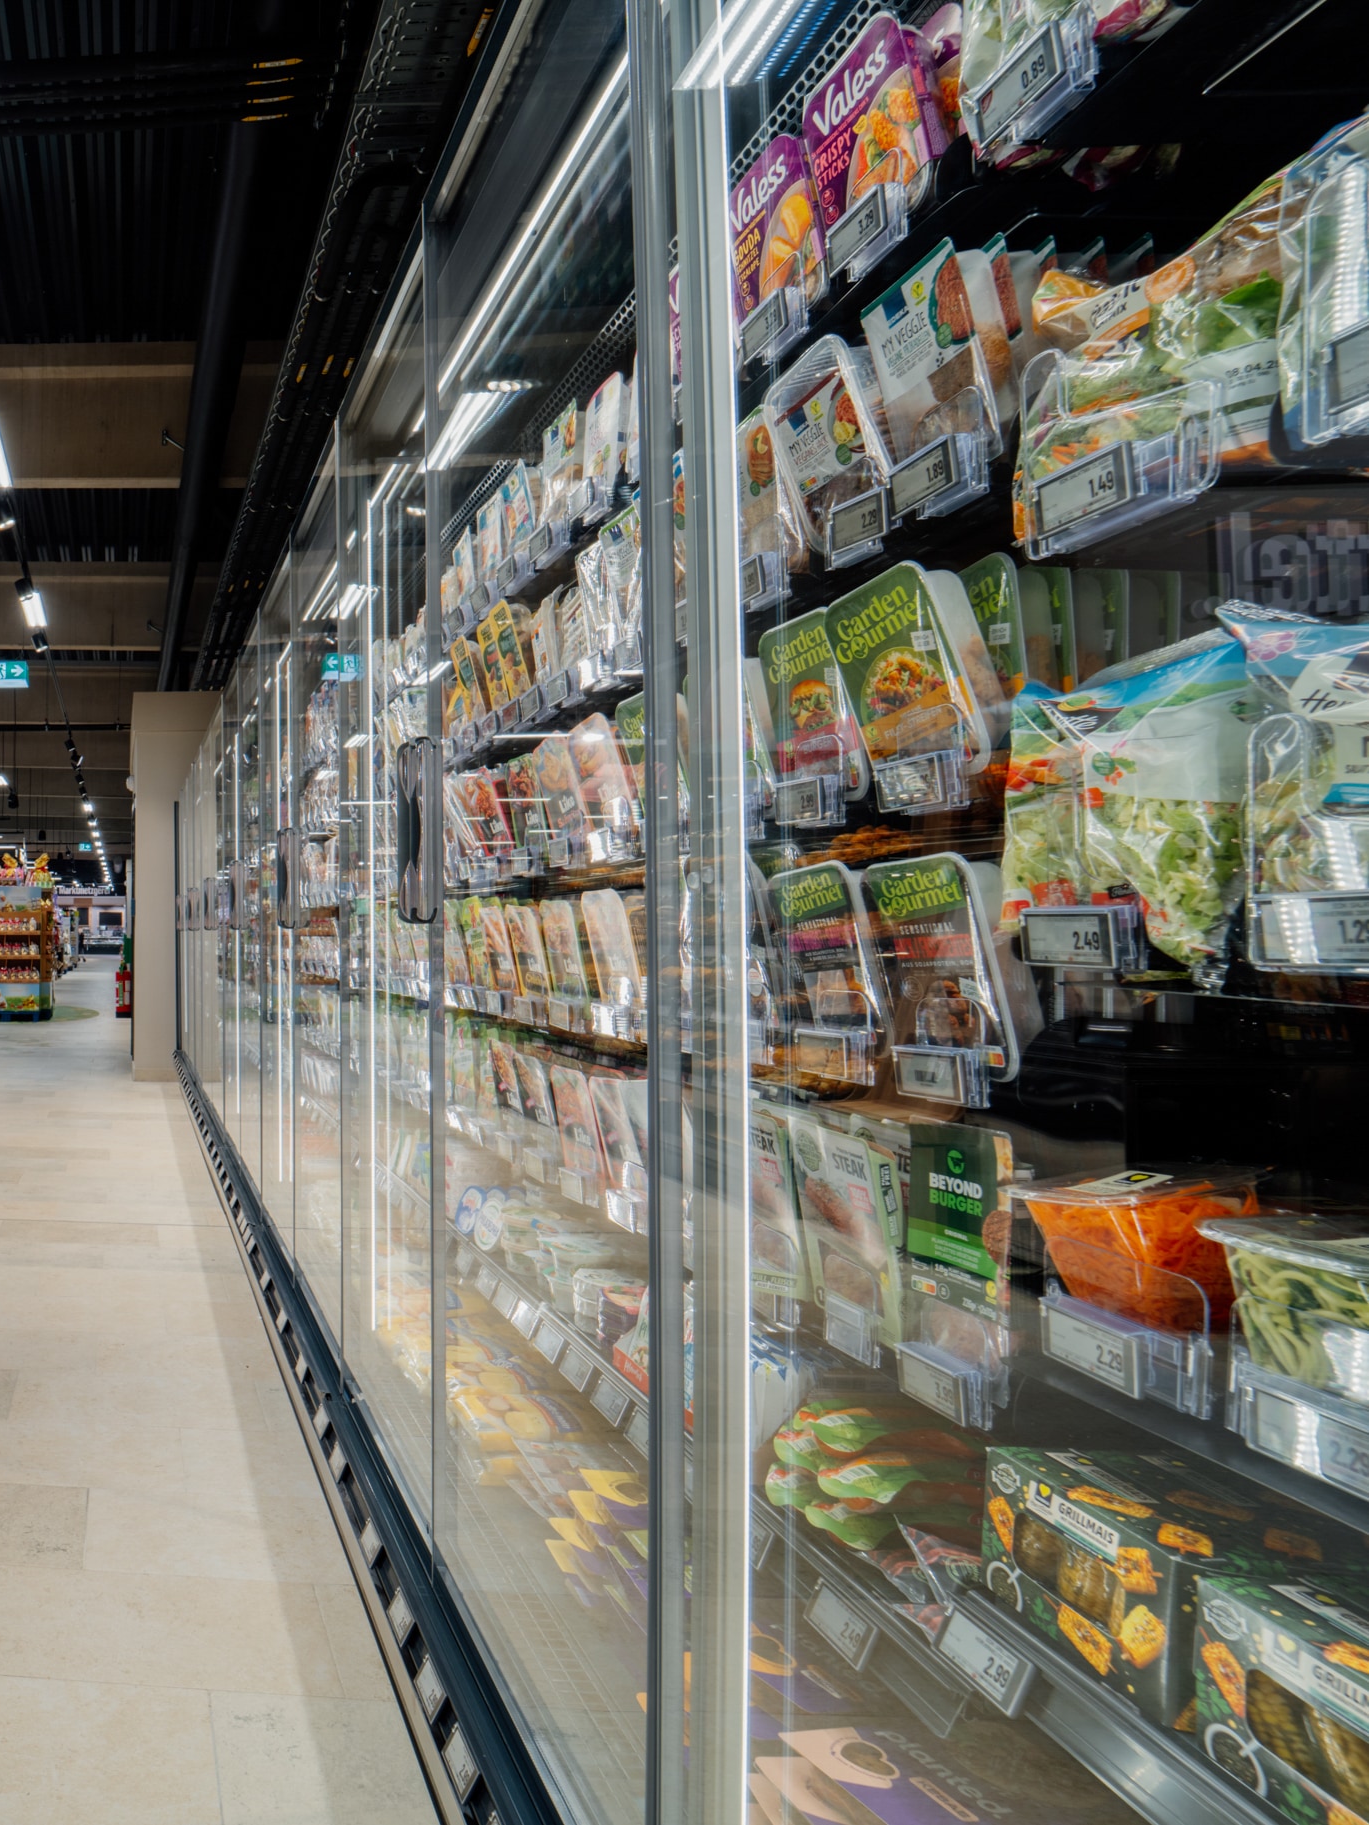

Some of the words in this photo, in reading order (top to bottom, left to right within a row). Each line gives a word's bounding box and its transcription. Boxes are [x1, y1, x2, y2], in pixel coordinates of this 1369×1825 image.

[1021, 54, 1046, 89] 0.89
[812, 40, 887, 137] Valess
[814, 127, 852, 176] CRISPY
[817, 150, 850, 191] STICKS
[730, 154, 786, 232] Valess
[857, 209, 874, 236] 3.29
[733, 227, 761, 267] GOUDA
[881, 336, 895, 359] MY
[894, 311, 928, 348] VEGGIE
[789, 438, 802, 458] MY
[801, 422, 825, 449] VEGGIE
[926, 459, 944, 484] 1.89
[1088, 470, 1115, 499] 1.49
[861, 508, 877, 529] 2.29
[835, 595, 924, 664] Gourmet
[836, 585, 909, 642] Garden
[771, 624, 827, 665] Garden
[768, 641, 832, 685] Gourme
[558, 793, 576, 814] Like
[490, 819, 504, 834] Like
[780, 882, 845, 917] Gourmet
[782, 872, 832, 902] Garden
[879, 880, 962, 917] Gourmet
[881, 868, 947, 898] Garden
[899, 921, 955, 935] SENSATIONAL
[1072, 930, 1100, 951] 2.49
[749, 1132, 777, 1156] TEAK
[833, 1153, 868, 1183] STEAK
[928, 1172, 983, 1200] BEYOND
[928, 1189, 983, 1218] BURGER
[1096, 1343, 1123, 1373] 2.29
[1058, 1502, 1115, 1546] GRILLMAIS
[839, 1622, 861, 1648] 2.49
[983, 1656, 1011, 1689] 2.99
[874, 1729, 1012, 1819] planted.
